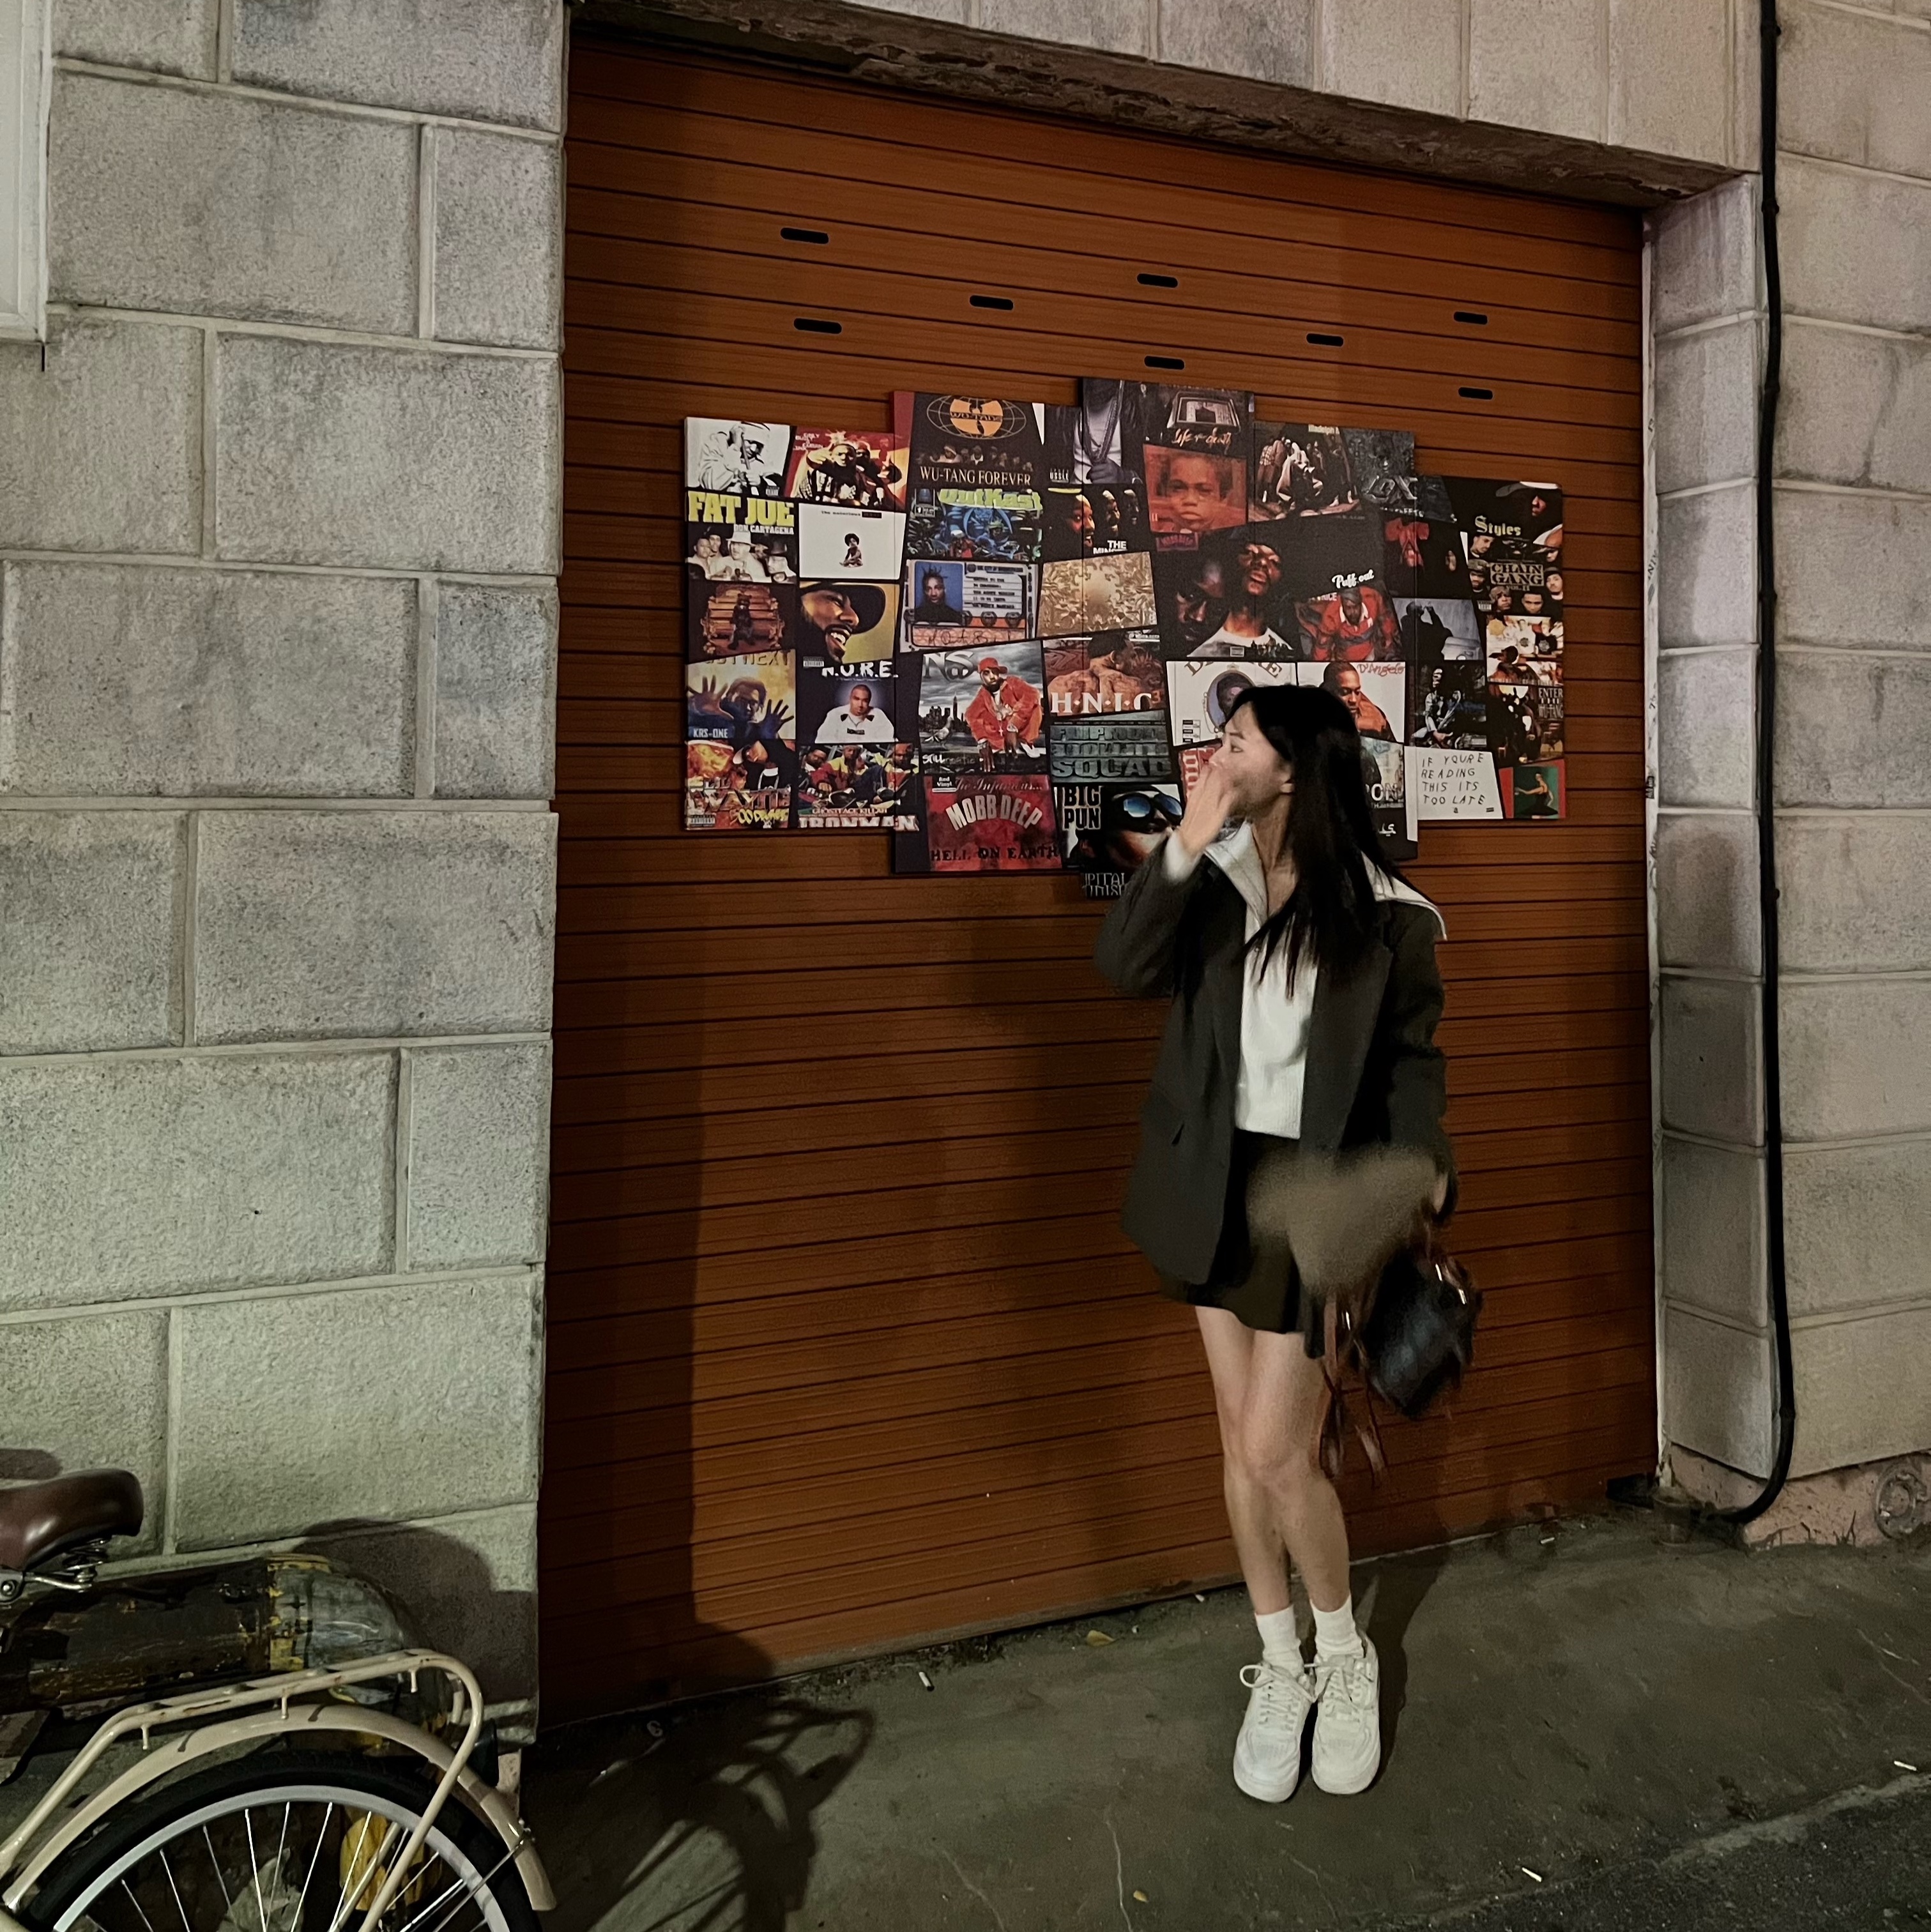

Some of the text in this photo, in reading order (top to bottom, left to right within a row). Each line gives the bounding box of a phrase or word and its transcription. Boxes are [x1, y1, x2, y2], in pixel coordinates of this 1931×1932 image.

[920, 466, 1031, 485] WU-TANG FOREVER
[688, 491, 741, 524] FAT
[751, 525, 794, 535] CARTAGENA
[1475, 515, 1522, 536] Styles
[1107, 540, 1127, 549] THE
[1492, 563, 1541, 574] CHAIN
[1492, 574, 1542, 585] GANG
[693, 728, 728, 738] KRS-ONE
[1423, 757, 1433, 767] IF
[1421, 768, 1475, 779] READING
[1422, 781, 1447, 792] THIS
[1062, 786, 1102, 807] BIG
[1424, 795, 1485, 805] TOO LATE
[945, 795, 1042, 830] MOBB DEEP
[1062, 807, 1101, 830] PUN
[931, 844, 1058, 861] HELL ON EARTH
